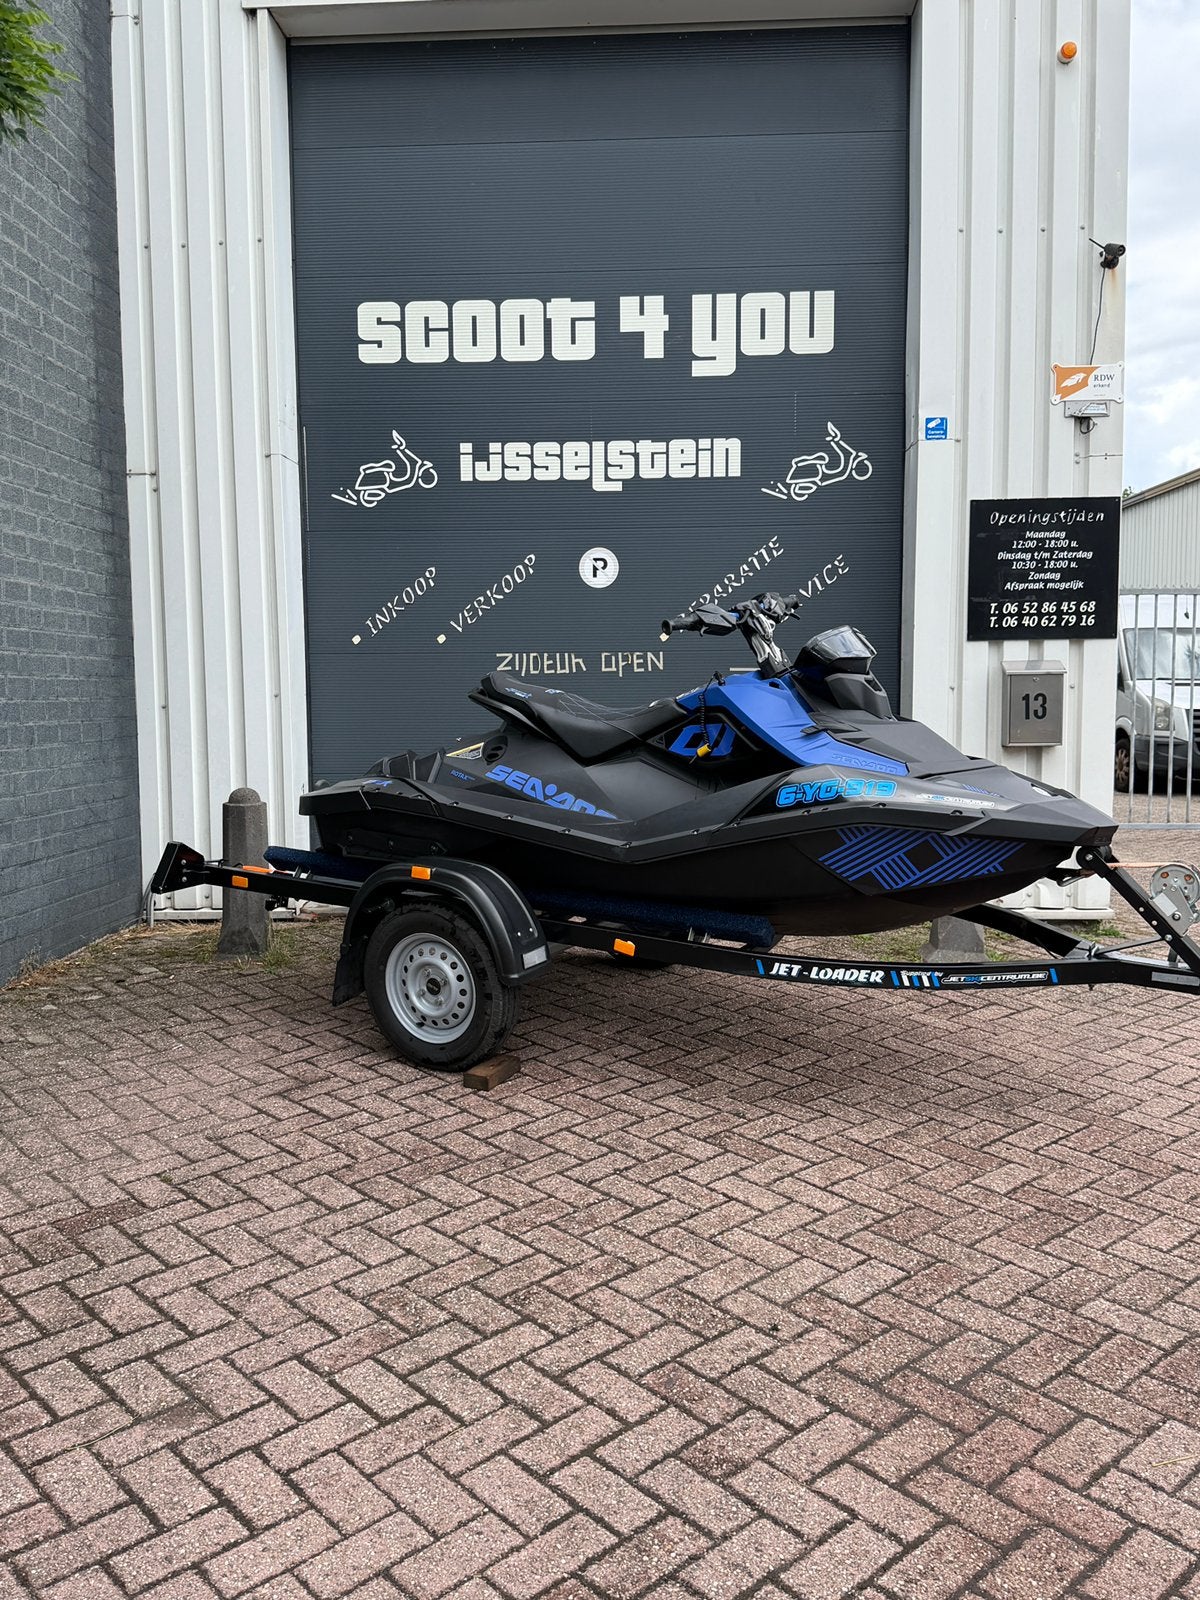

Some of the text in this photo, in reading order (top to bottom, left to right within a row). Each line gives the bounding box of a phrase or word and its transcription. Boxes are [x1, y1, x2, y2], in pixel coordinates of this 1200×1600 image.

[619, 295, 669, 359] 4
[1093, 374, 1115, 382] RDW
[989, 508, 1105, 526] Openingstijden
[1025, 530, 1066, 539] Maandag
[1012, 540, 1037, 549] 12:00
[1044, 539, 1069, 548] 18:00
[1070, 540, 1079, 548] u.
[997, 550, 1093, 561] Dinsdag t/m Zaterdag
[1011, 561, 1037, 569] 10:30
[1044, 560, 1068, 569] 18:00
[1028, 571, 1061, 581] Zondag
[677, 535, 784, 633] PARATIE
[1004, 580, 1085, 591] Afspraak mogelijk
[450, 553, 536, 633] VERKOOP
[365, 566, 436, 638] INKOOP
[989, 601, 1096, 614] T. 06 52 86 45 68
[989, 615, 1096, 628] T. 06 40 62 79 16
[601, 651, 664, 677] OPEN
[1021, 692, 1048, 720] 13
[943, 972, 1047, 983] JETSKICENTRUM.BE
